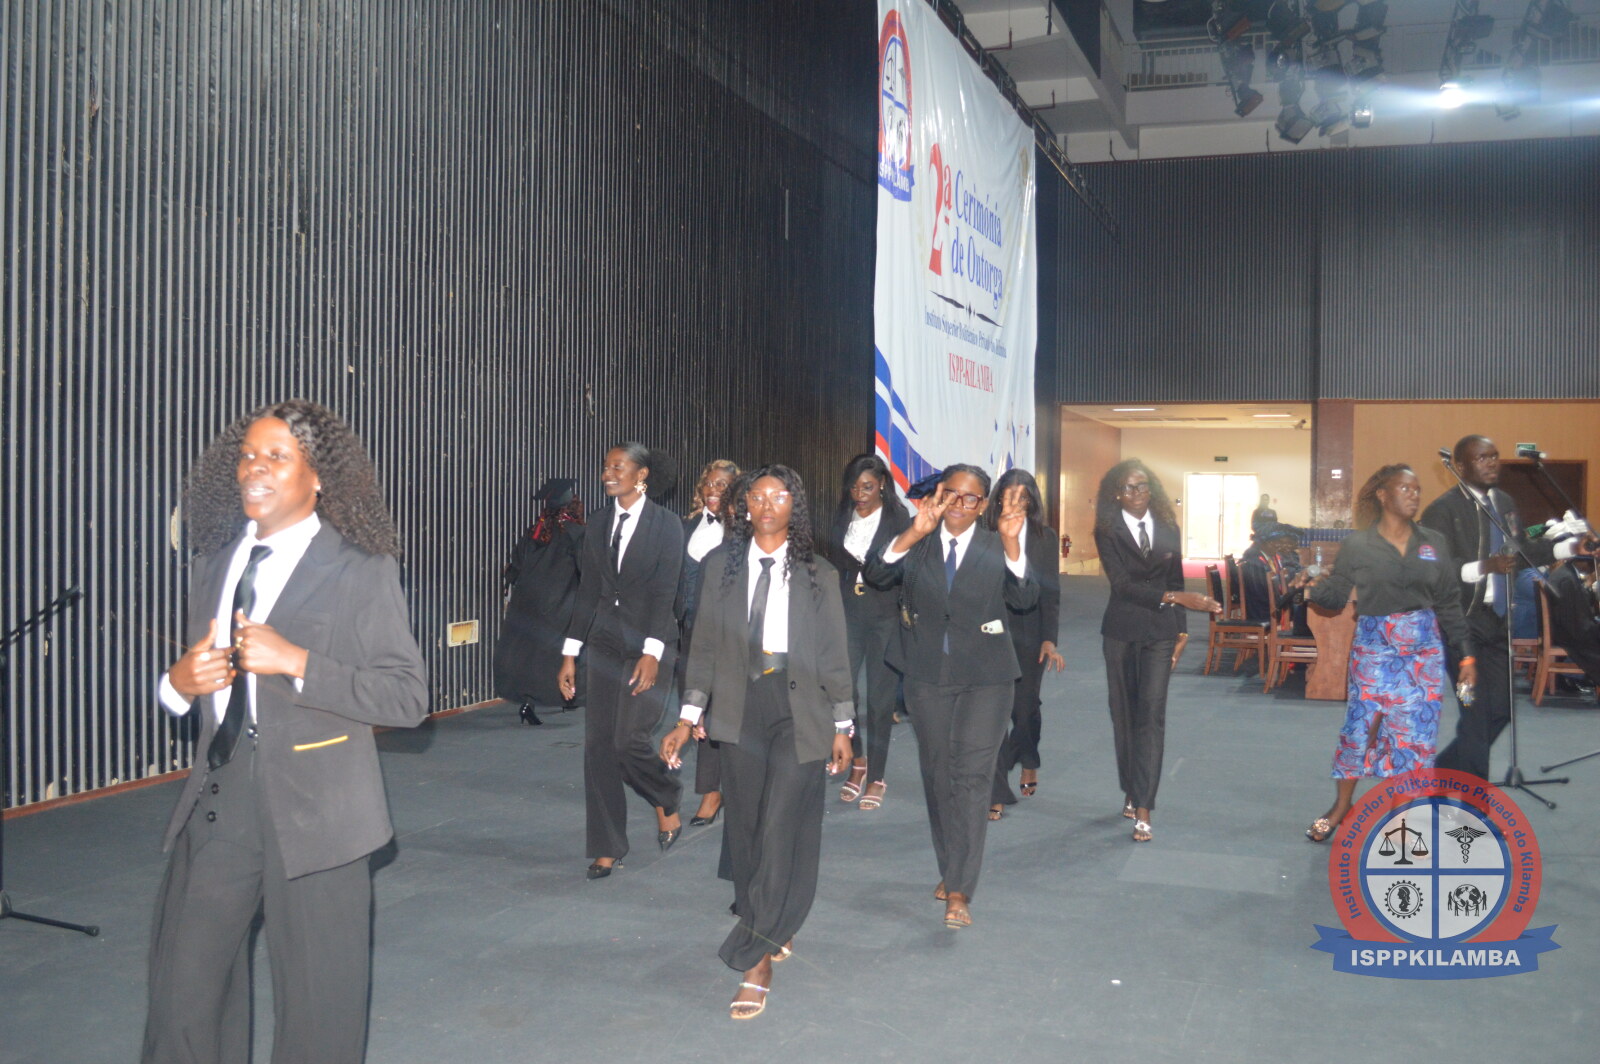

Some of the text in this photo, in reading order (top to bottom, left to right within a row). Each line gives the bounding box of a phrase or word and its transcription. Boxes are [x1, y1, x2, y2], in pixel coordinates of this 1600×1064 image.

[955, 169, 1002, 249] Cerimónia
[951, 226, 1003, 310] de Outorga
[949, 352, 994, 393] ISPP-KILAMBA
